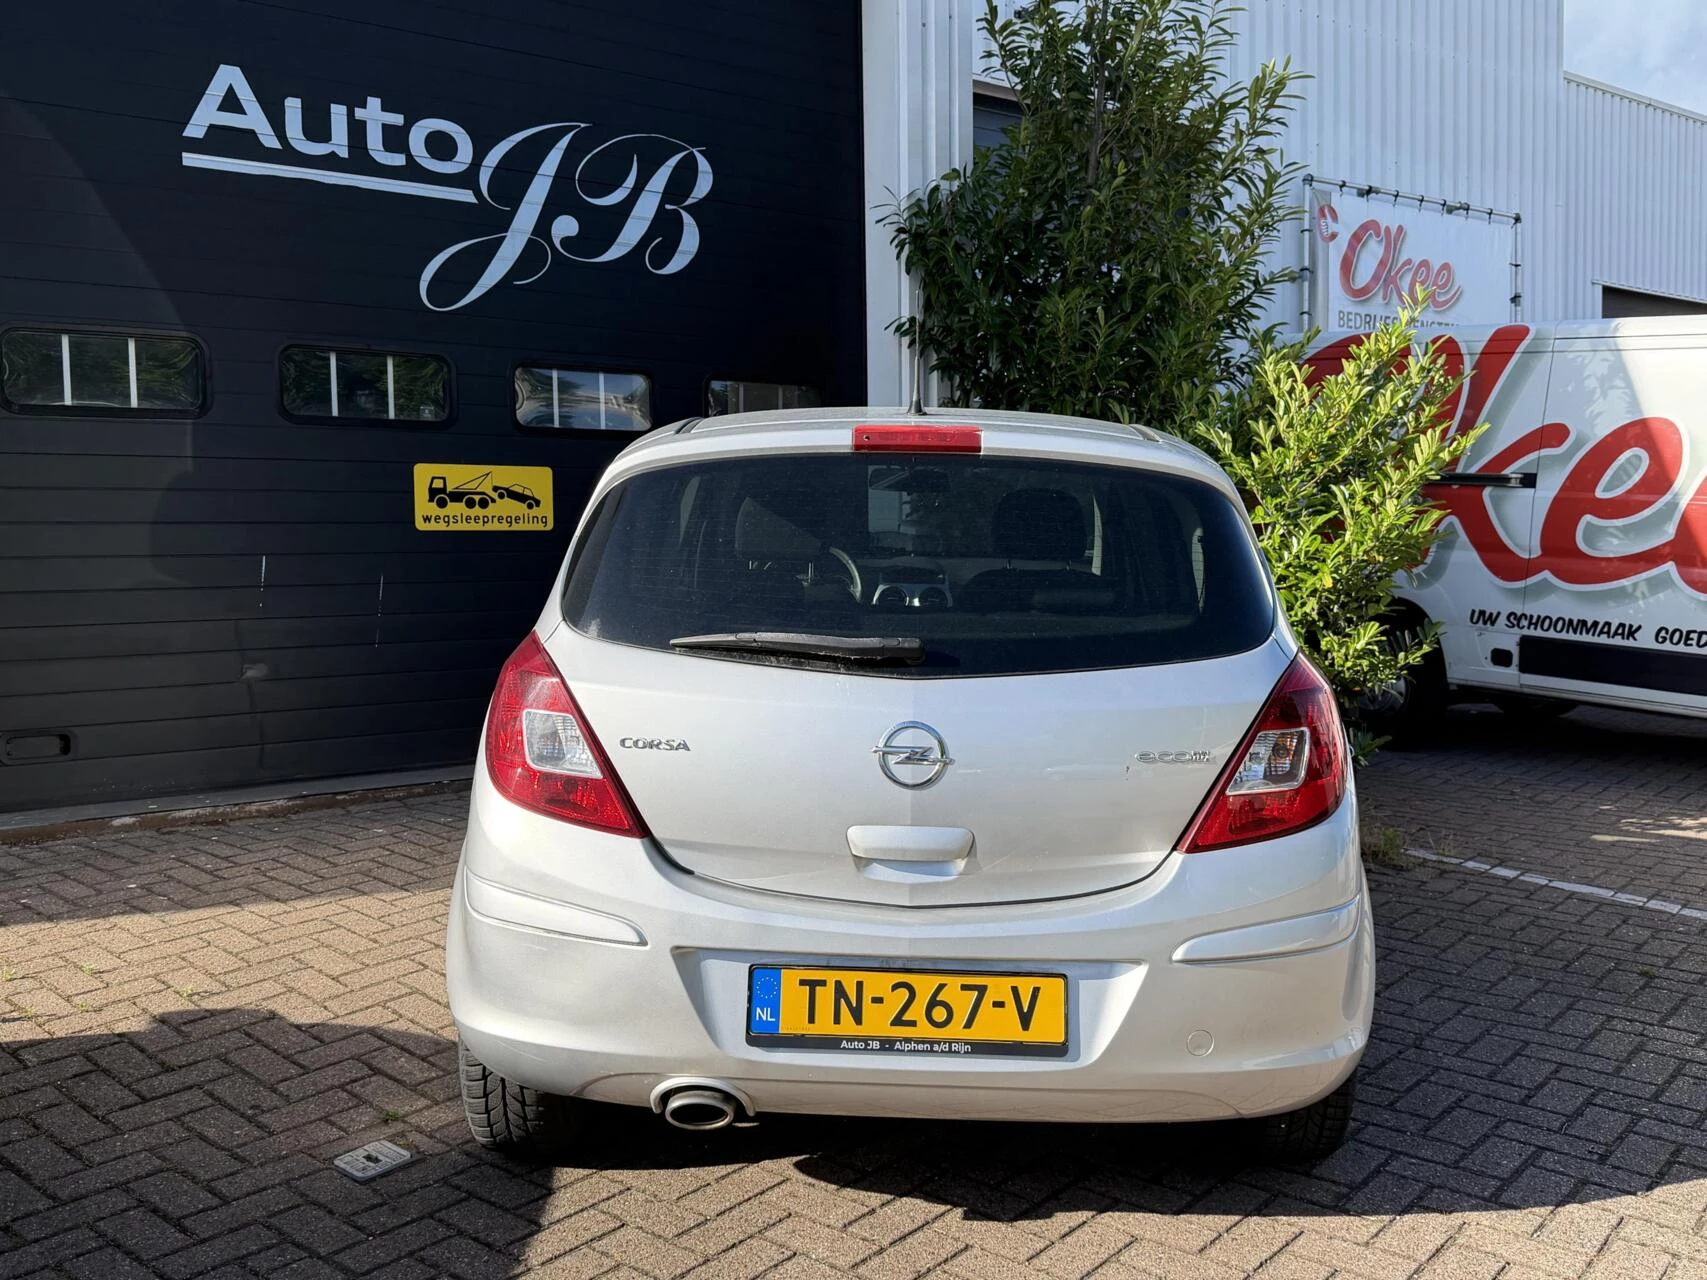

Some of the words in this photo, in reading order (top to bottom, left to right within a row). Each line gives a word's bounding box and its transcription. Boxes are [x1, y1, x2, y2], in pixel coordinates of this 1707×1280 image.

[182, 63, 474, 174] Auto
[418, 122, 713, 312] JB
[421, 512, 549, 528] wegsleepregeling
[1468, 608, 1502, 627] UW
[1504, 611, 1643, 642] SCHOONMAAK
[619, 736, 691, 752] CORSA
[798, 978, 1041, 1032] TN-267-V
[755, 1006, 776, 1022] NL
[840, 1040, 865, 1050] Auto
[867, 1040, 880, 1050] JB
[894, 1041, 931, 1053] Alphen
[933, 1042, 949, 1053] a/d
[951, 1042, 972, 1054] Rijn
